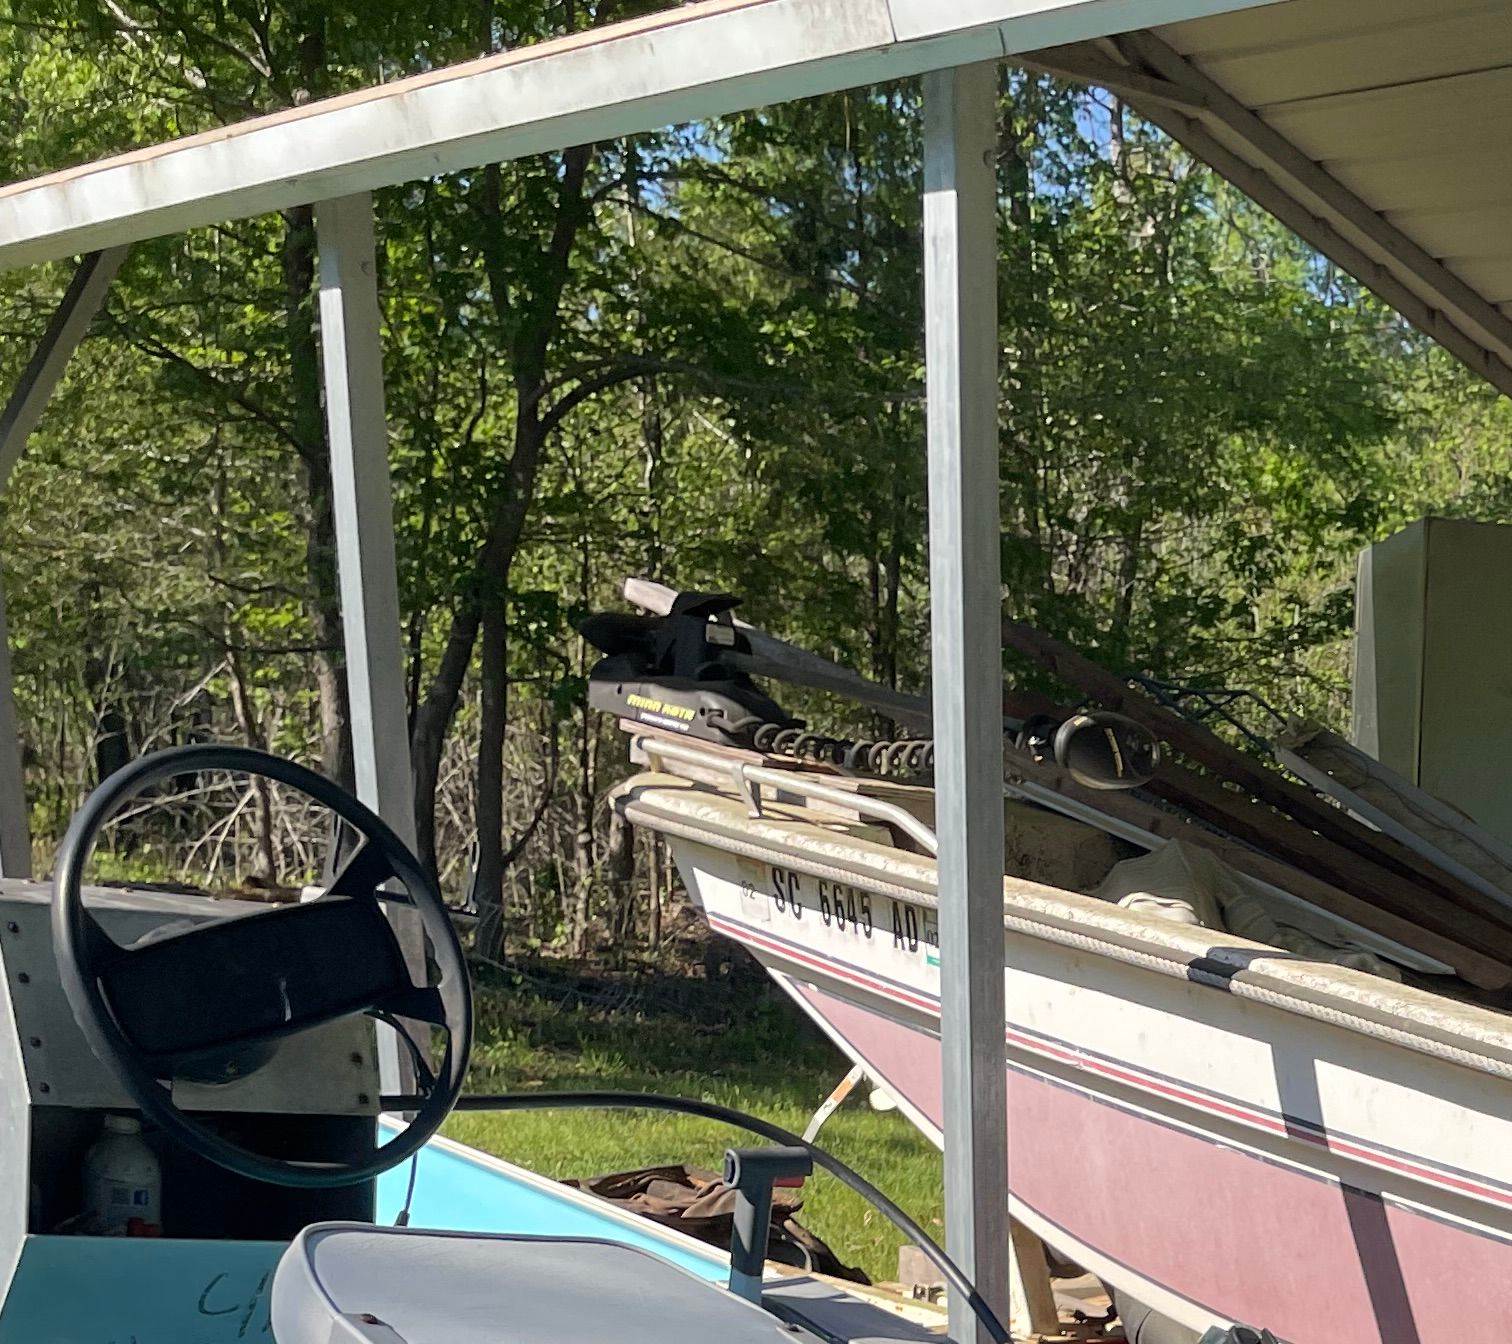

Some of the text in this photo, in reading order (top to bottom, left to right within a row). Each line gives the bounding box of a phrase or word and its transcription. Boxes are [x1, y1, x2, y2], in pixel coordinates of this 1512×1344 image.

[772, 867, 918, 953] SC 6645 AD
